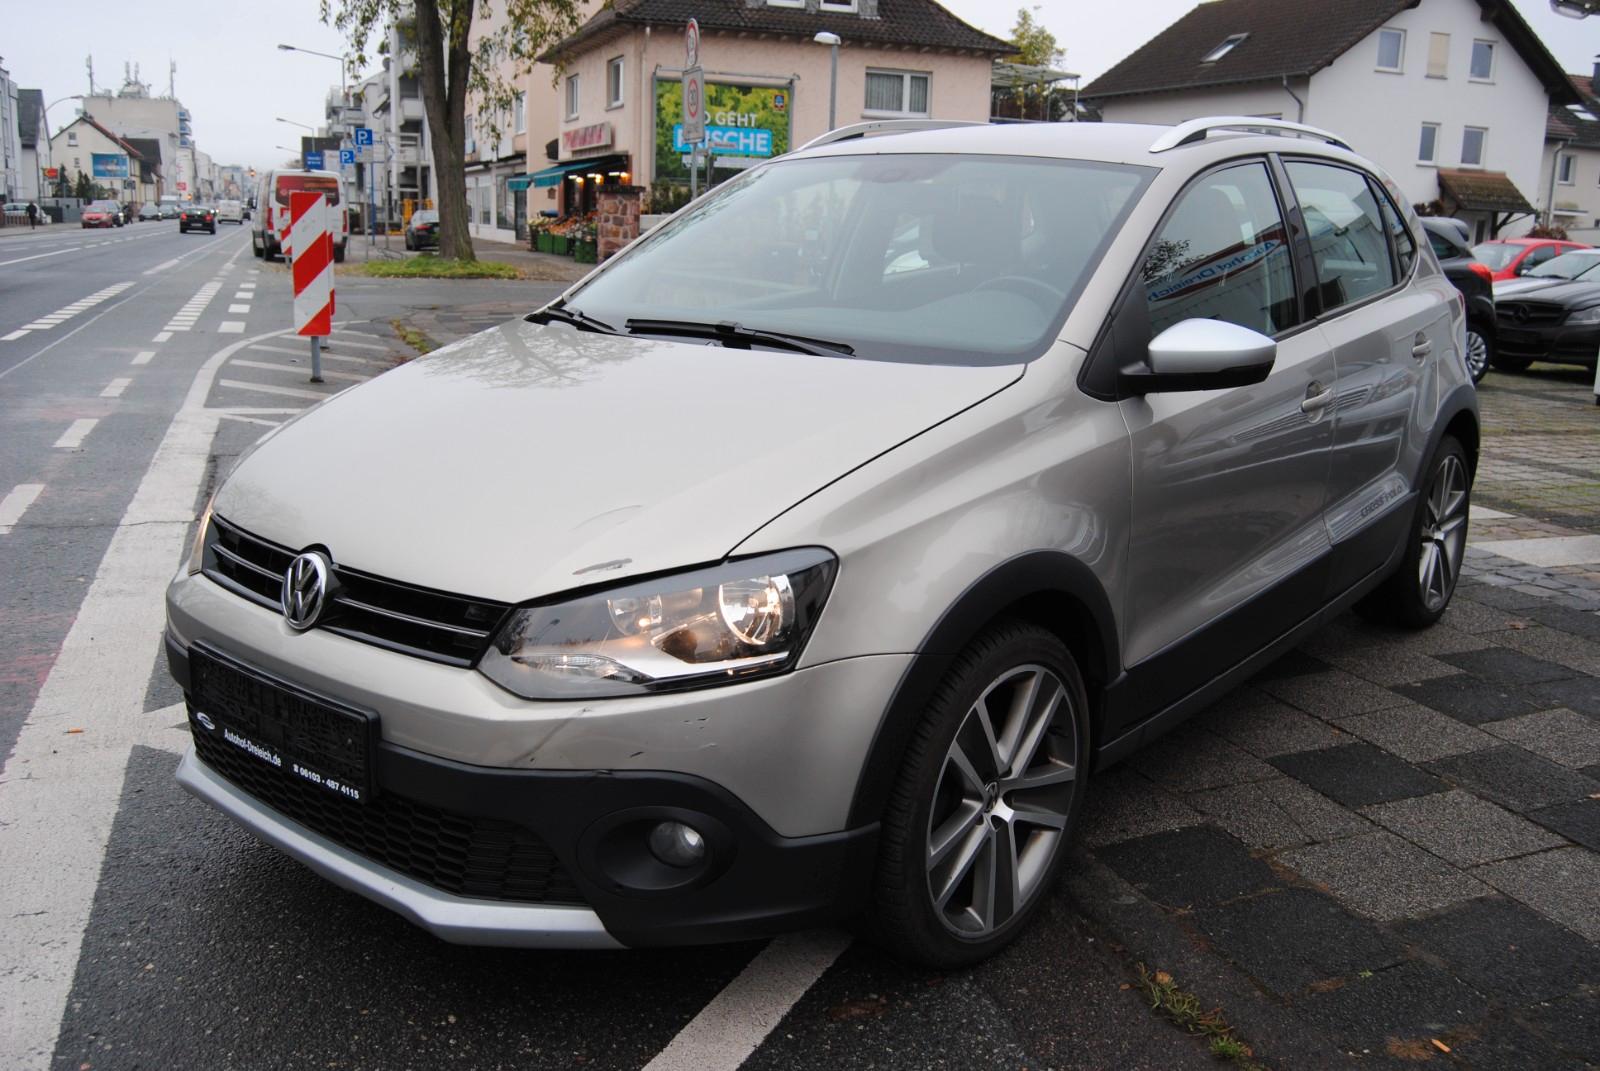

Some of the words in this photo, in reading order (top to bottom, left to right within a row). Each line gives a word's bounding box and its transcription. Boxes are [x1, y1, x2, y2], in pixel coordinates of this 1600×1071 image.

[715, 112, 758, 127] GEHT
[357, 130, 369, 145] P
[341, 151, 351, 163] P
[224, 728, 282, 767] Autohof-Dreieich.de
[341, 785, 360, 799] 4115
